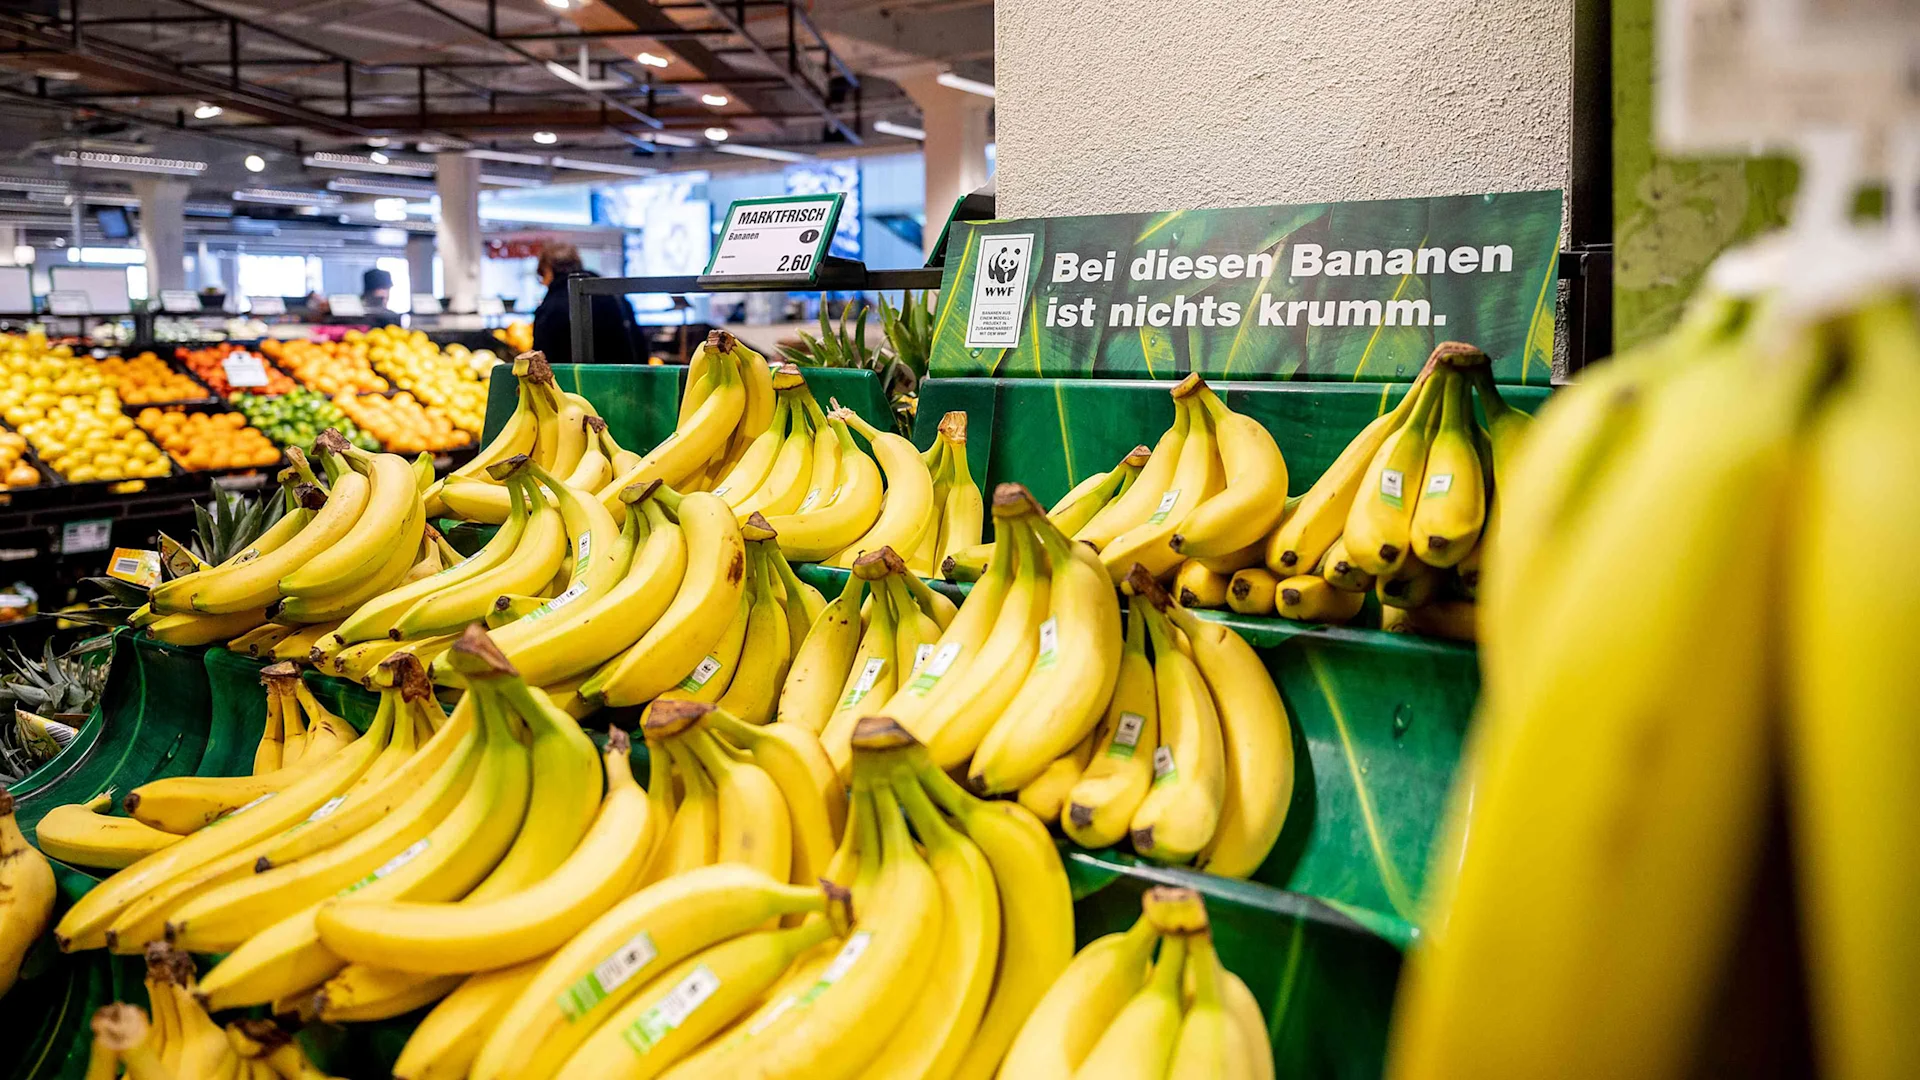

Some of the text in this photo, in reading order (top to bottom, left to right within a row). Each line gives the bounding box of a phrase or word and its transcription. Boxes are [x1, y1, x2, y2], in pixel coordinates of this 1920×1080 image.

[737, 207, 826, 225] MARKTFRISCH
[728, 232, 760, 241] Bananen
[776, 254, 812, 272] 2.60
[1051, 243, 1514, 283] Bei diesen Bananen
[985, 287, 1015, 297] WWF
[1045, 293, 1448, 328] ist nichts krumm.
